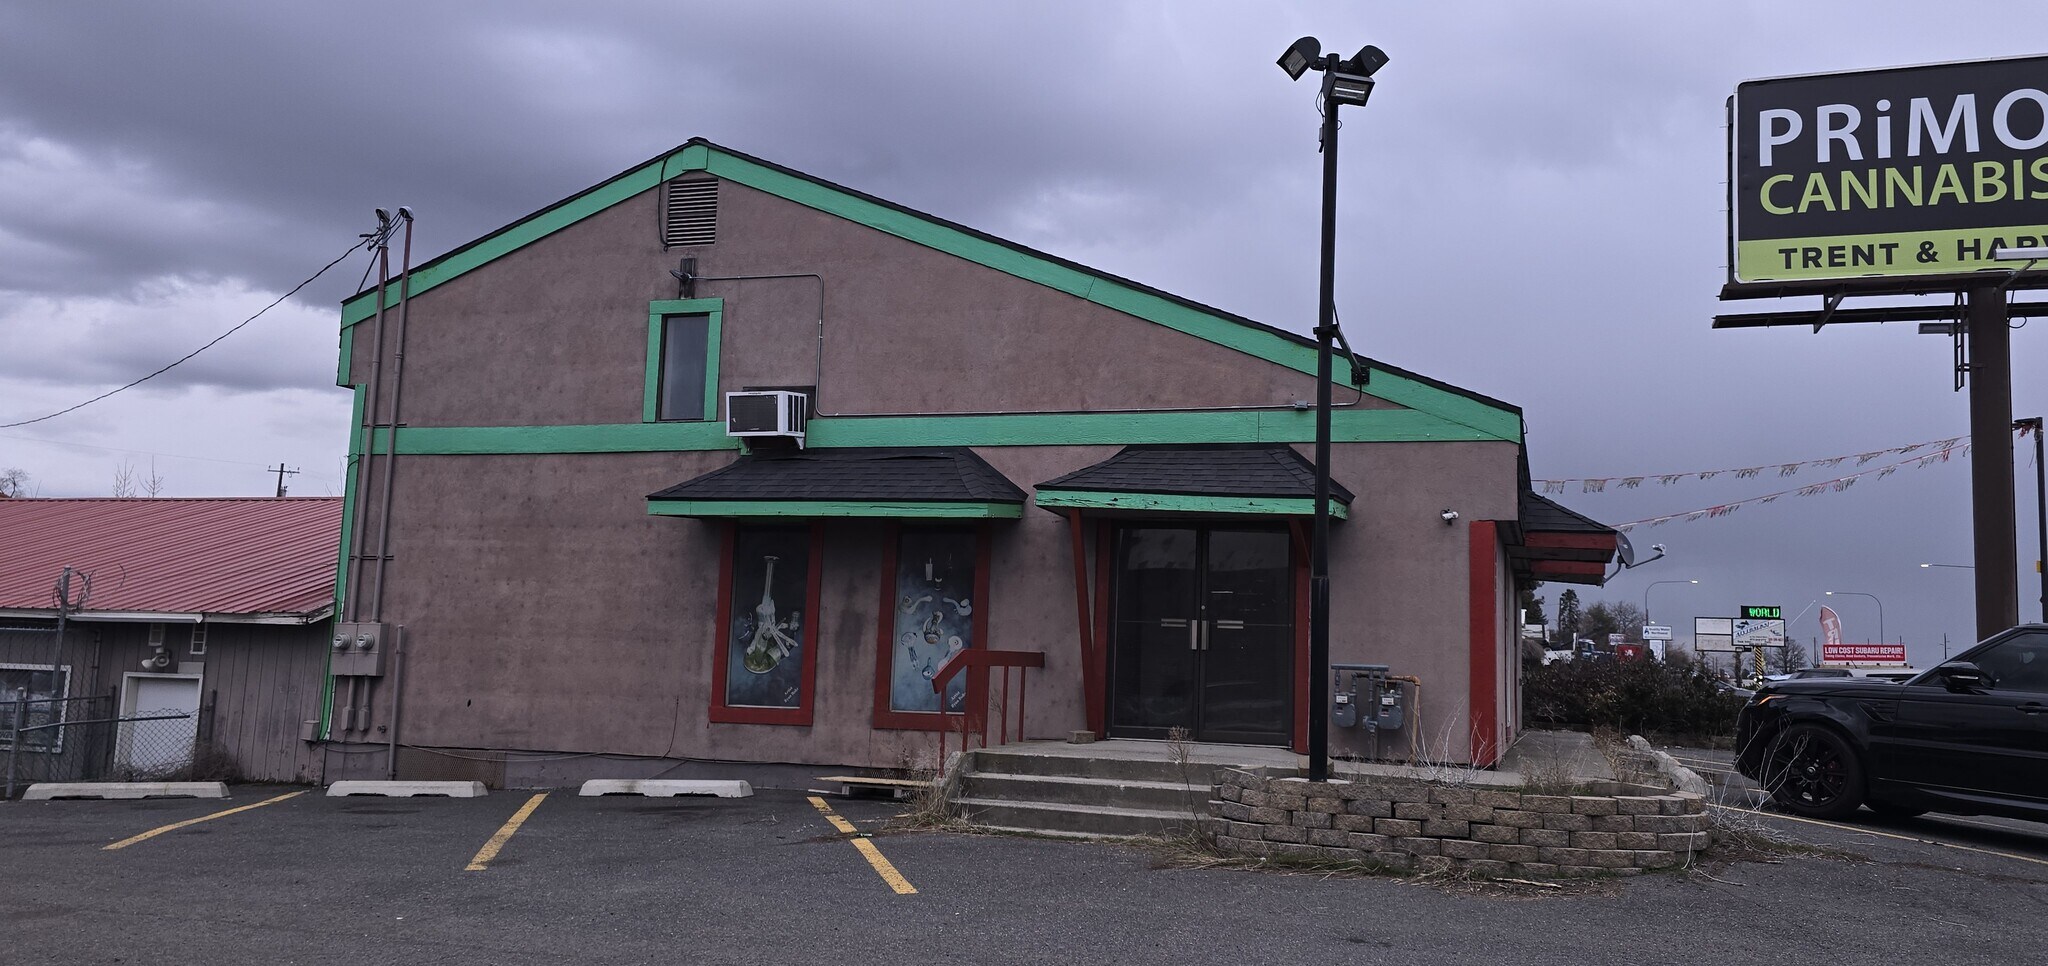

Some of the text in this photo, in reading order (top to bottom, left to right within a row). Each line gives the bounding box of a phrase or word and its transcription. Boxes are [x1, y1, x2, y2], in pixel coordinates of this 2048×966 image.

[1759, 88, 2048, 167] PRiMO
[1760, 156, 2048, 215] CANNABIS
[1778, 243, 1899, 269] TRENT
[1916, 241, 1939, 263] &
[1749, 607, 1780, 618] WORLD
[1825, 646, 1838, 654] LOW
[1839, 646, 1854, 654] COST
[1855, 646, 1879, 655] SUBARU
